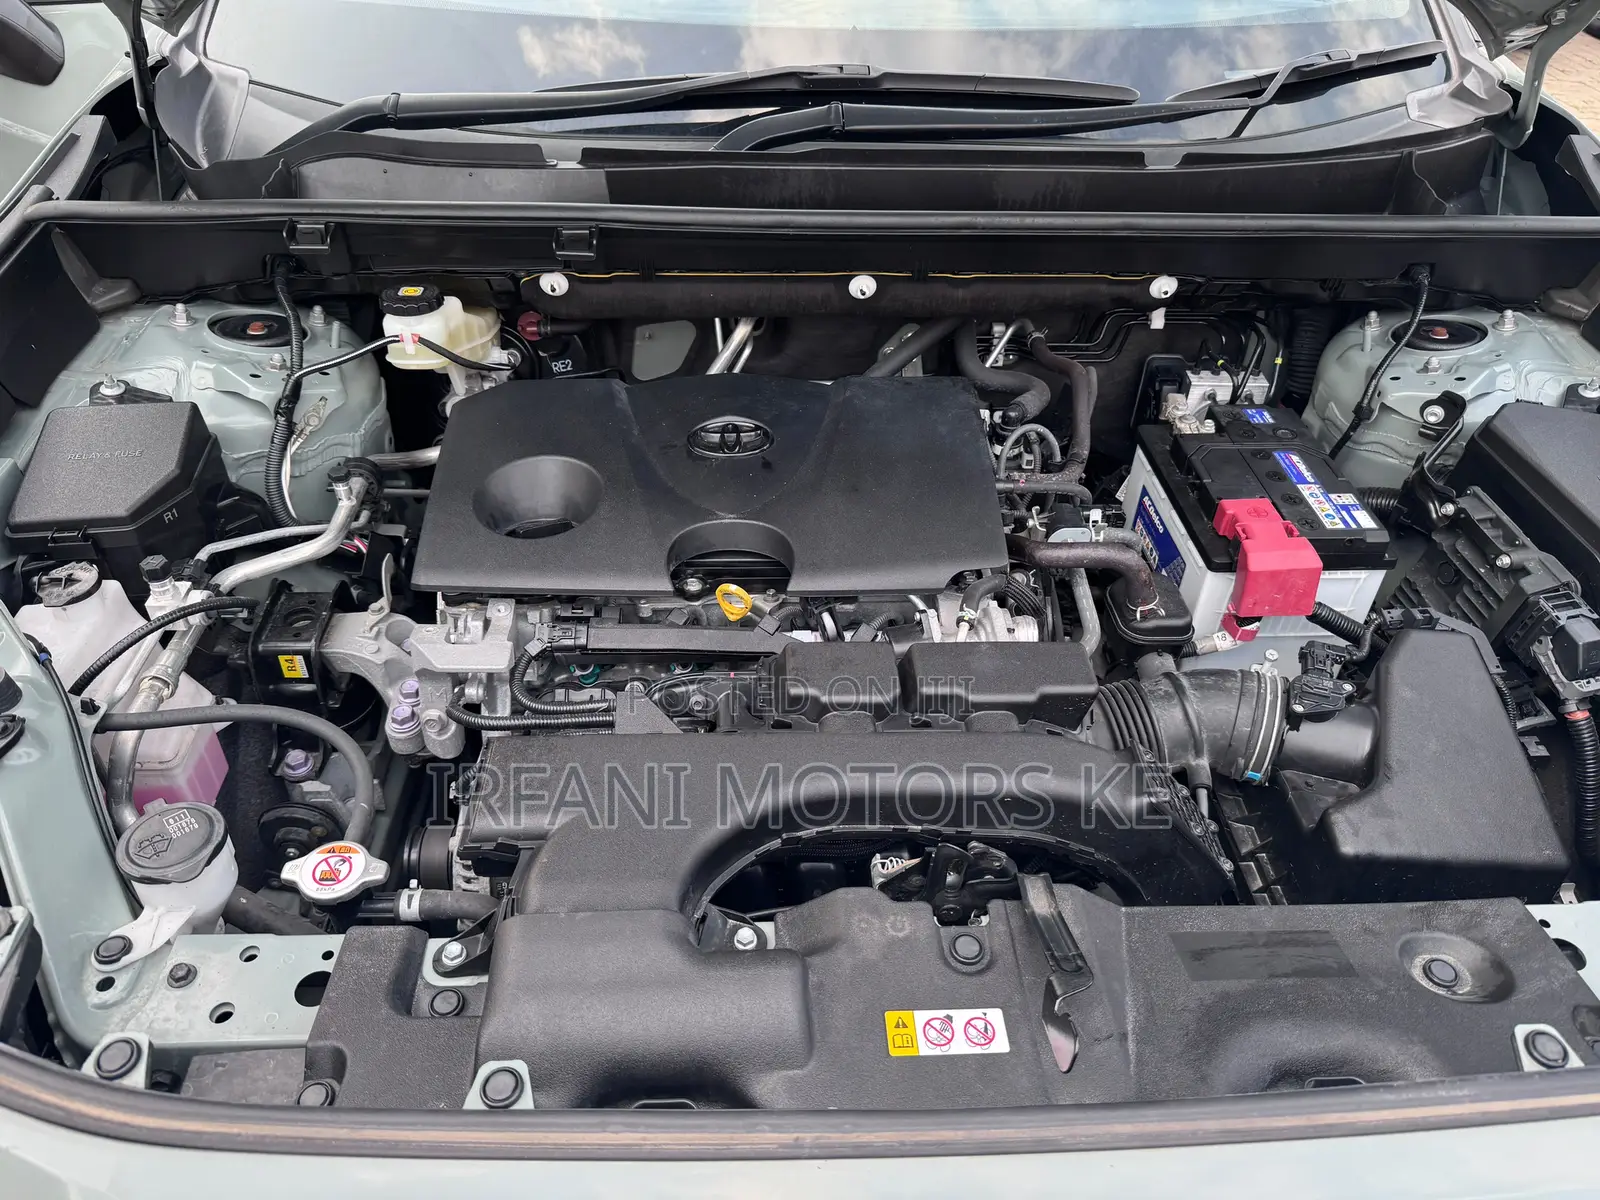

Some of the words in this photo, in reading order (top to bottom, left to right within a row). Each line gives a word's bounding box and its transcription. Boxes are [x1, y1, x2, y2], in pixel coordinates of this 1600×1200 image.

[551, 359, 573, 373] RE2
[67, 451, 103, 461] RELAY
[115, 449, 143, 458] FUSE
[163, 507, 178, 524] R1
[1142, 495, 1164, 534] ACDelco
[1216, 632, 1227, 642] 18
